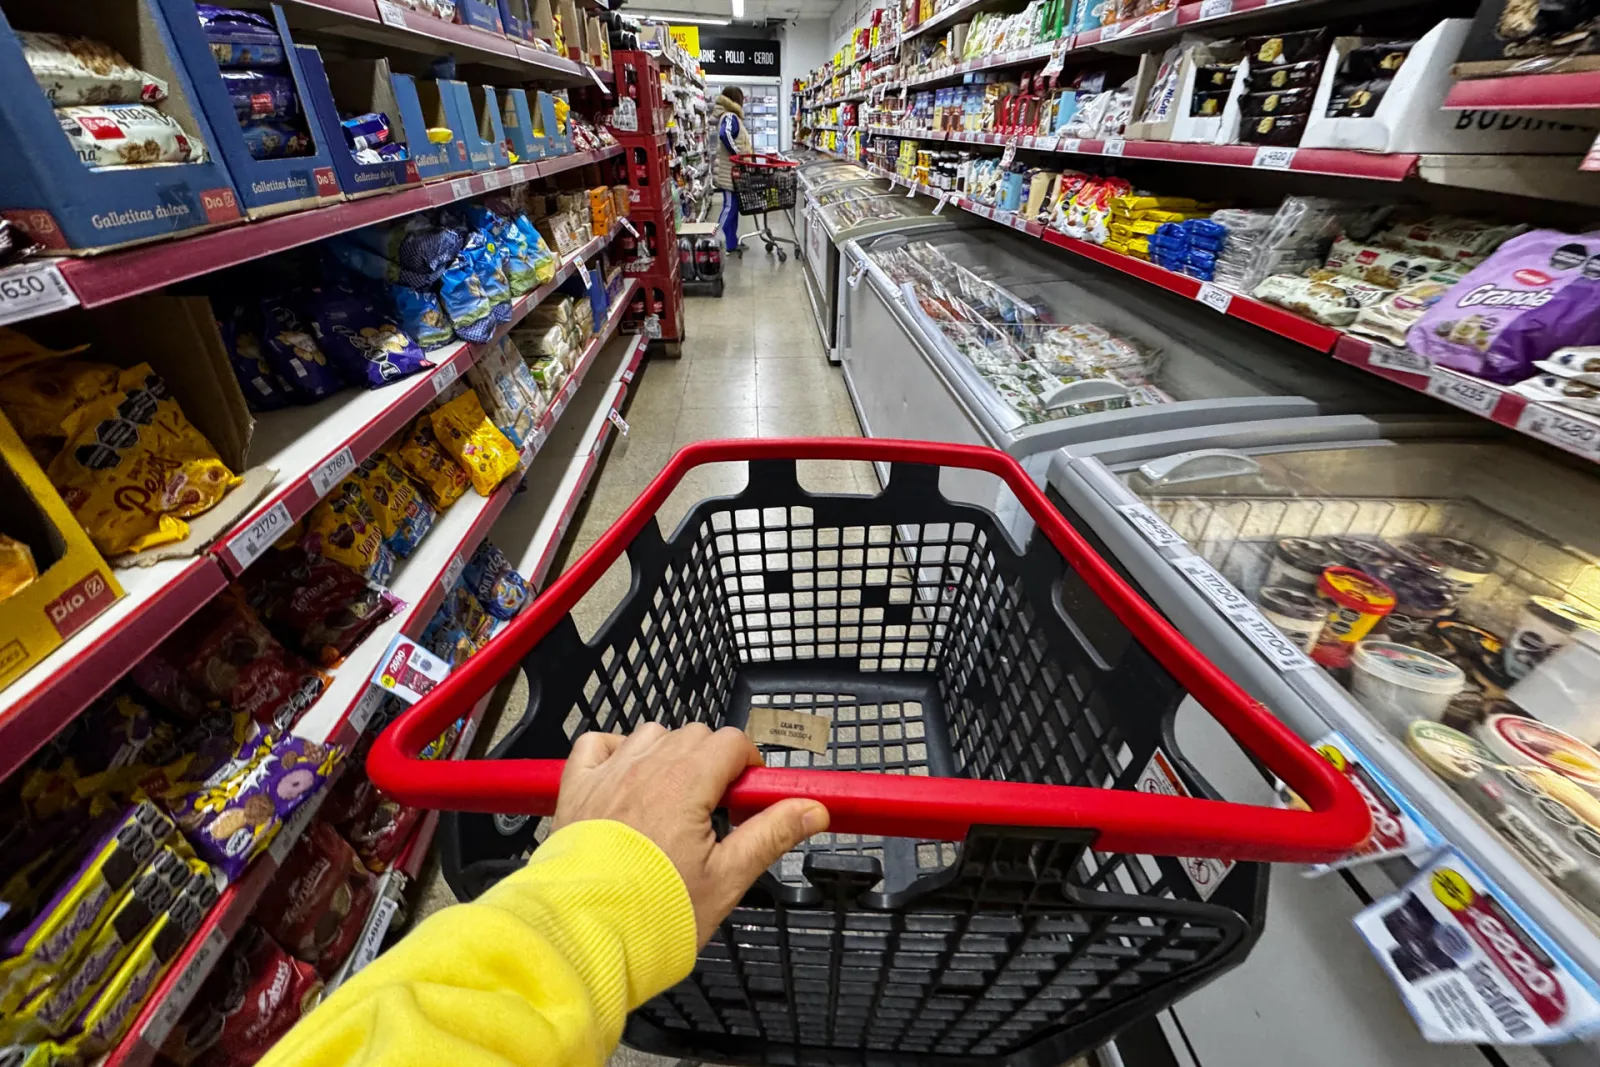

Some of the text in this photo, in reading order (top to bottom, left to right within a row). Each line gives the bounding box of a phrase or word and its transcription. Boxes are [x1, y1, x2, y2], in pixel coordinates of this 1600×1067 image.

[699, 49, 774, 65] ARNE POLLO CERDO
[252, 176, 308, 194] Galletitas dulces
[354, 170, 380, 183] Galletitas
[91, 202, 190, 230] Galletitas dulces
[0, 275, 46, 299] 630
[1456, 283, 1556, 309] Granola
[327, 455, 347, 477] 3769
[252, 515, 278, 541] 2170
[1203, 572, 1239, 602] 11700
[1250, 621, 1294, 657] 11700
